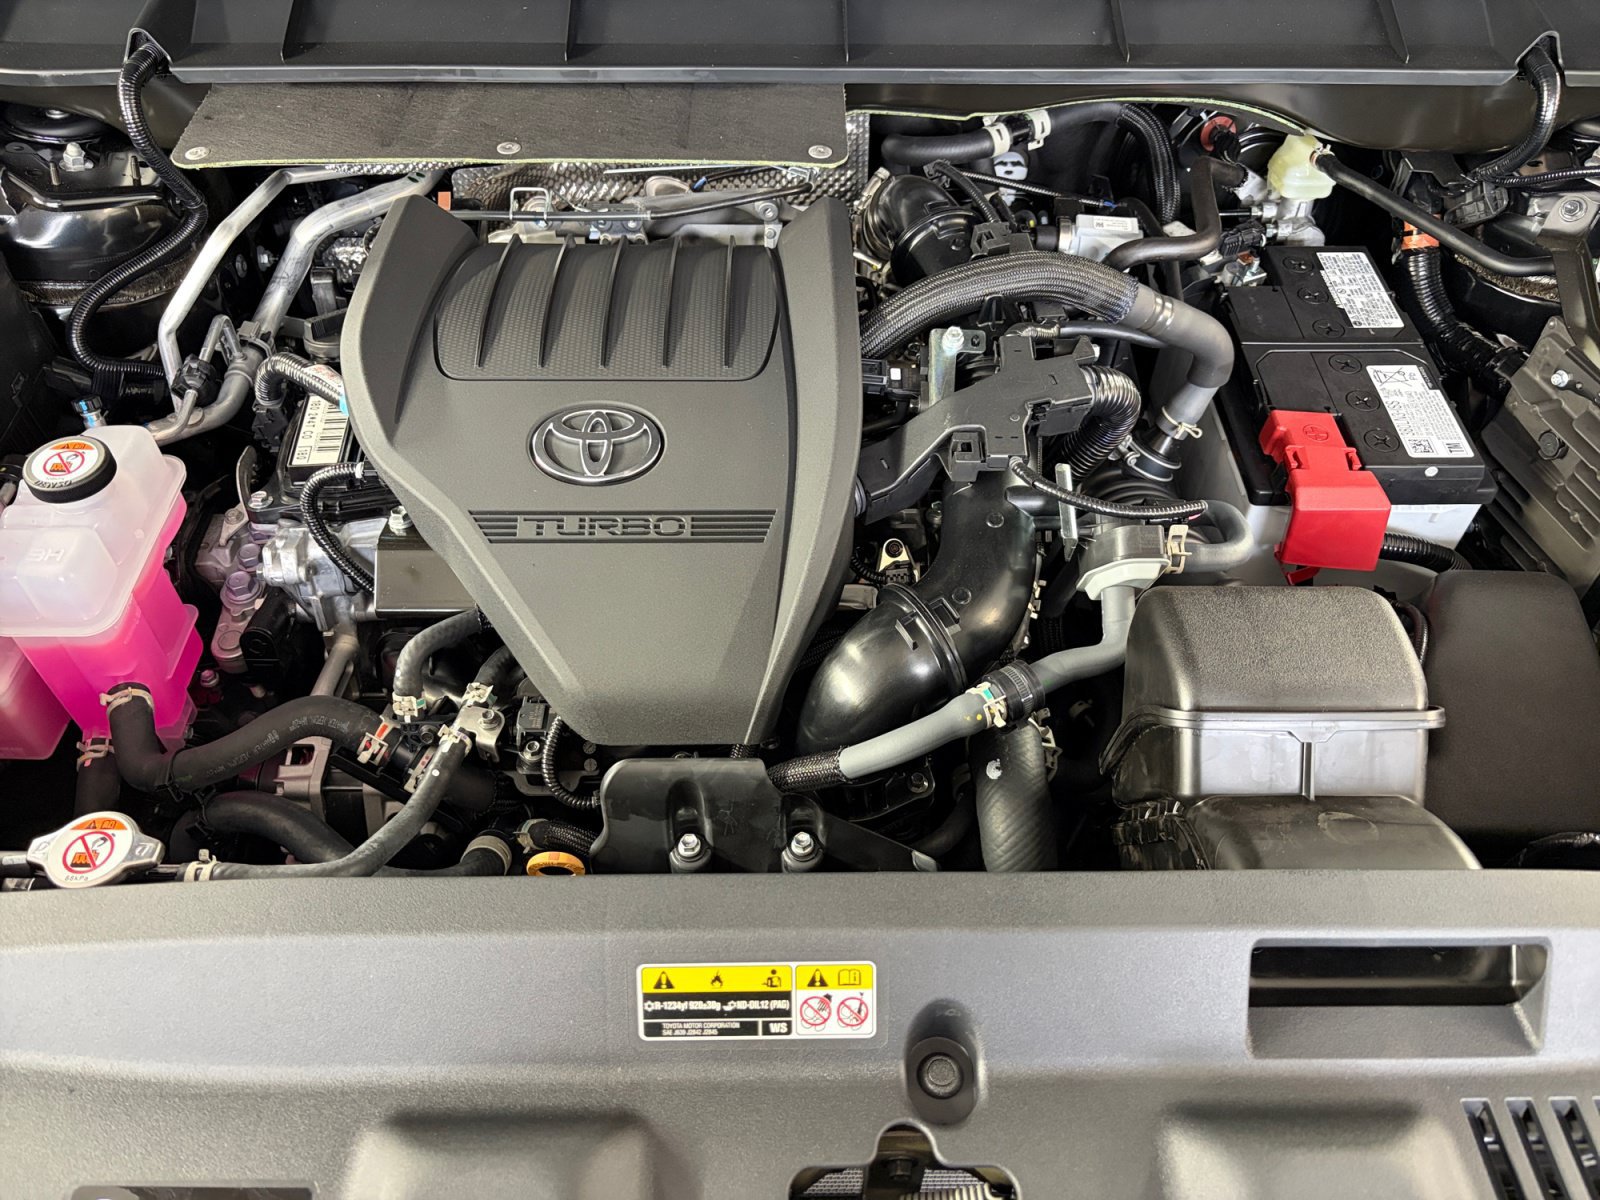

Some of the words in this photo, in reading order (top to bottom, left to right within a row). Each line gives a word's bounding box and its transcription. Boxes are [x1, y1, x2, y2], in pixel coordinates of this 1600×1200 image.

[523, 515, 688, 537] TURBO
[654, 1001, 688, 1011] R-1234yf
[770, 1000, 790, 1011] (PAG)
[769, 1022, 788, 1033] WS
